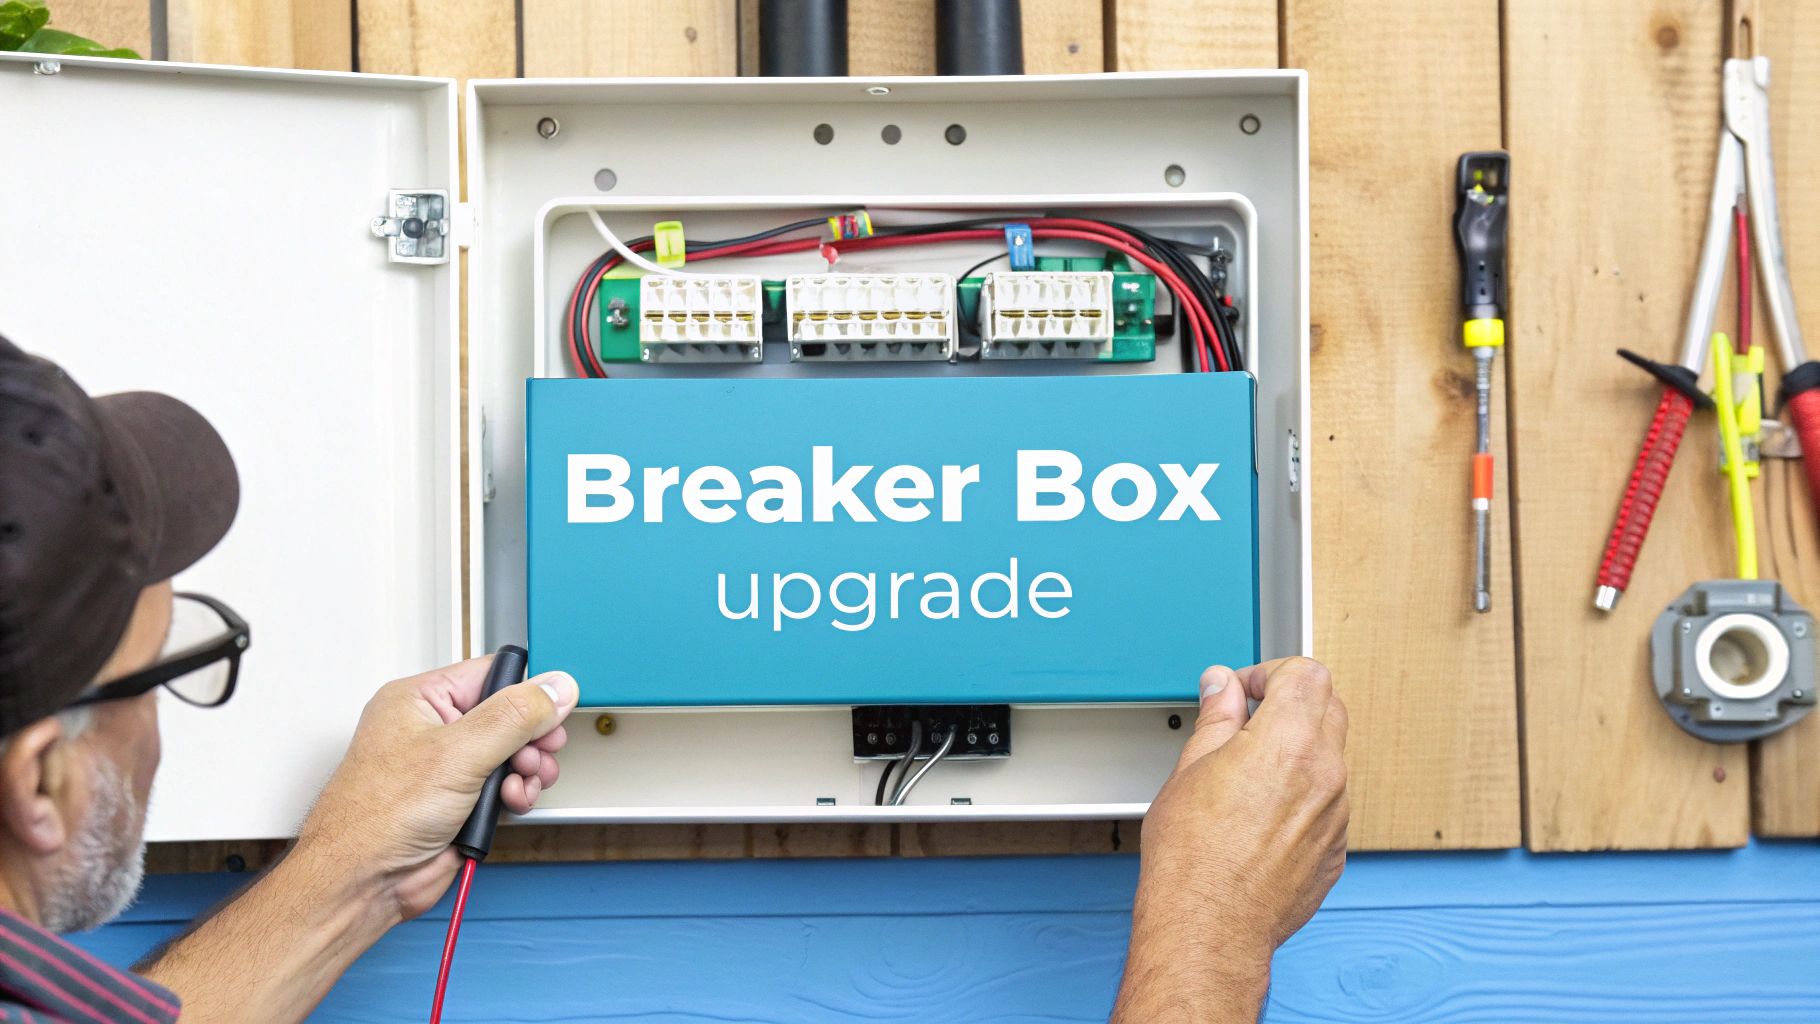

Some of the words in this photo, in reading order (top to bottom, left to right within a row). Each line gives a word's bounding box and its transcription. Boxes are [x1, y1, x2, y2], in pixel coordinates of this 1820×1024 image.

[566, 445, 980, 524] Breaker
[1016, 449, 1221, 523] Box
[717, 557, 1074, 632] upgrade
